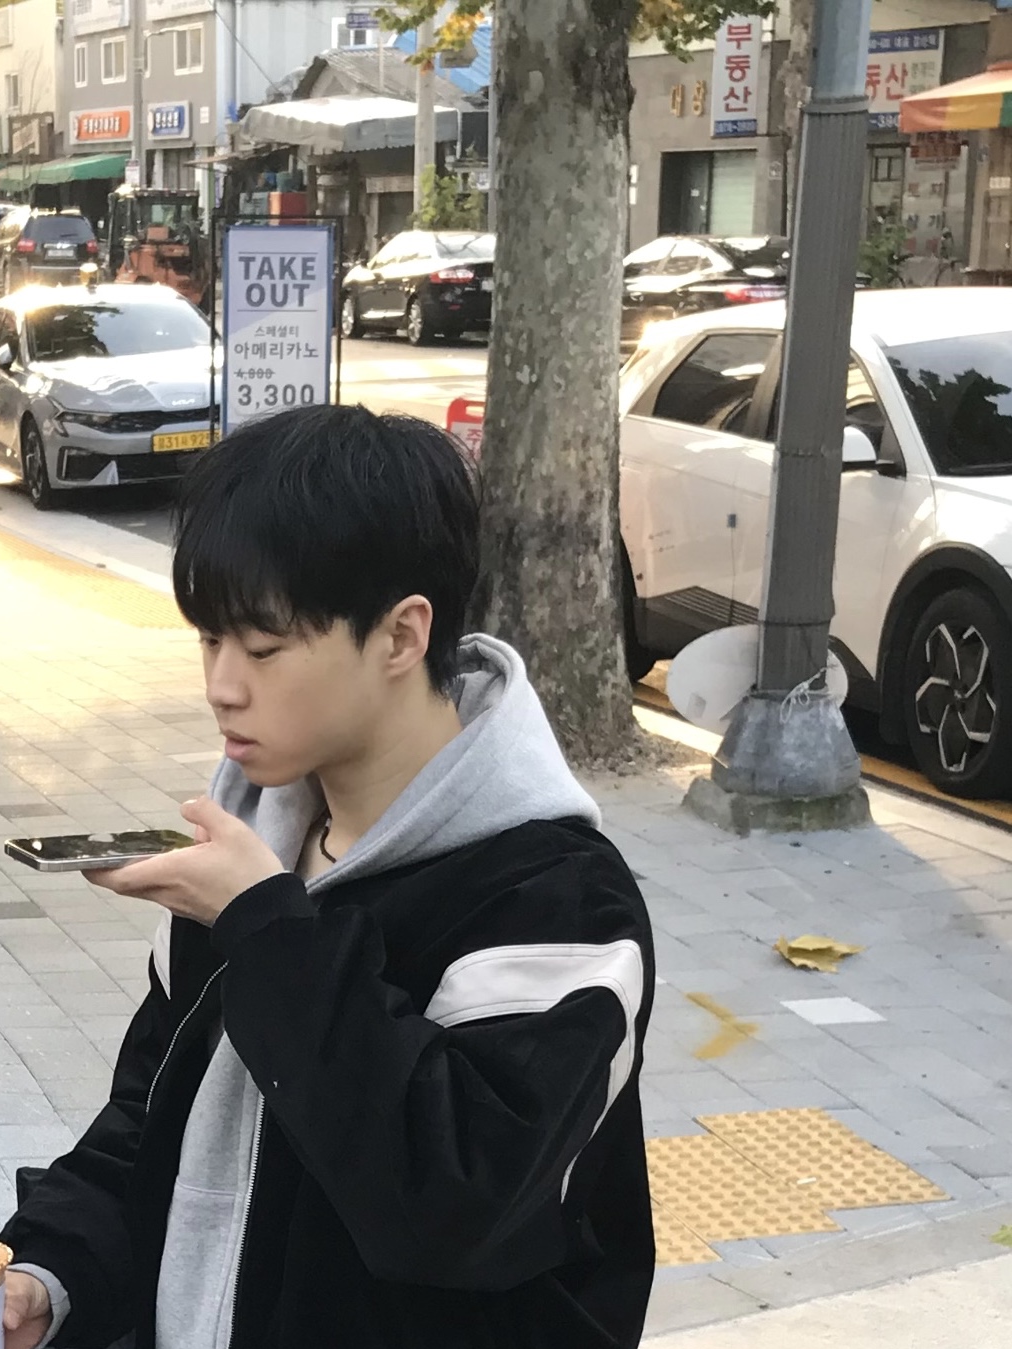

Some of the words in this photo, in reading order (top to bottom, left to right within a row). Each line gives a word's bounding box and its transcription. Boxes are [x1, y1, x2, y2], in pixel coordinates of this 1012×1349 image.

[725, 23, 752, 113] 부동산
[238, 256, 317, 281] TAKE
[245, 283, 311, 308] OUT
[254, 325, 300, 338] 스페셜티
[234, 341, 319, 360] 아메리카노
[237, 383, 315, 409] 3,300
